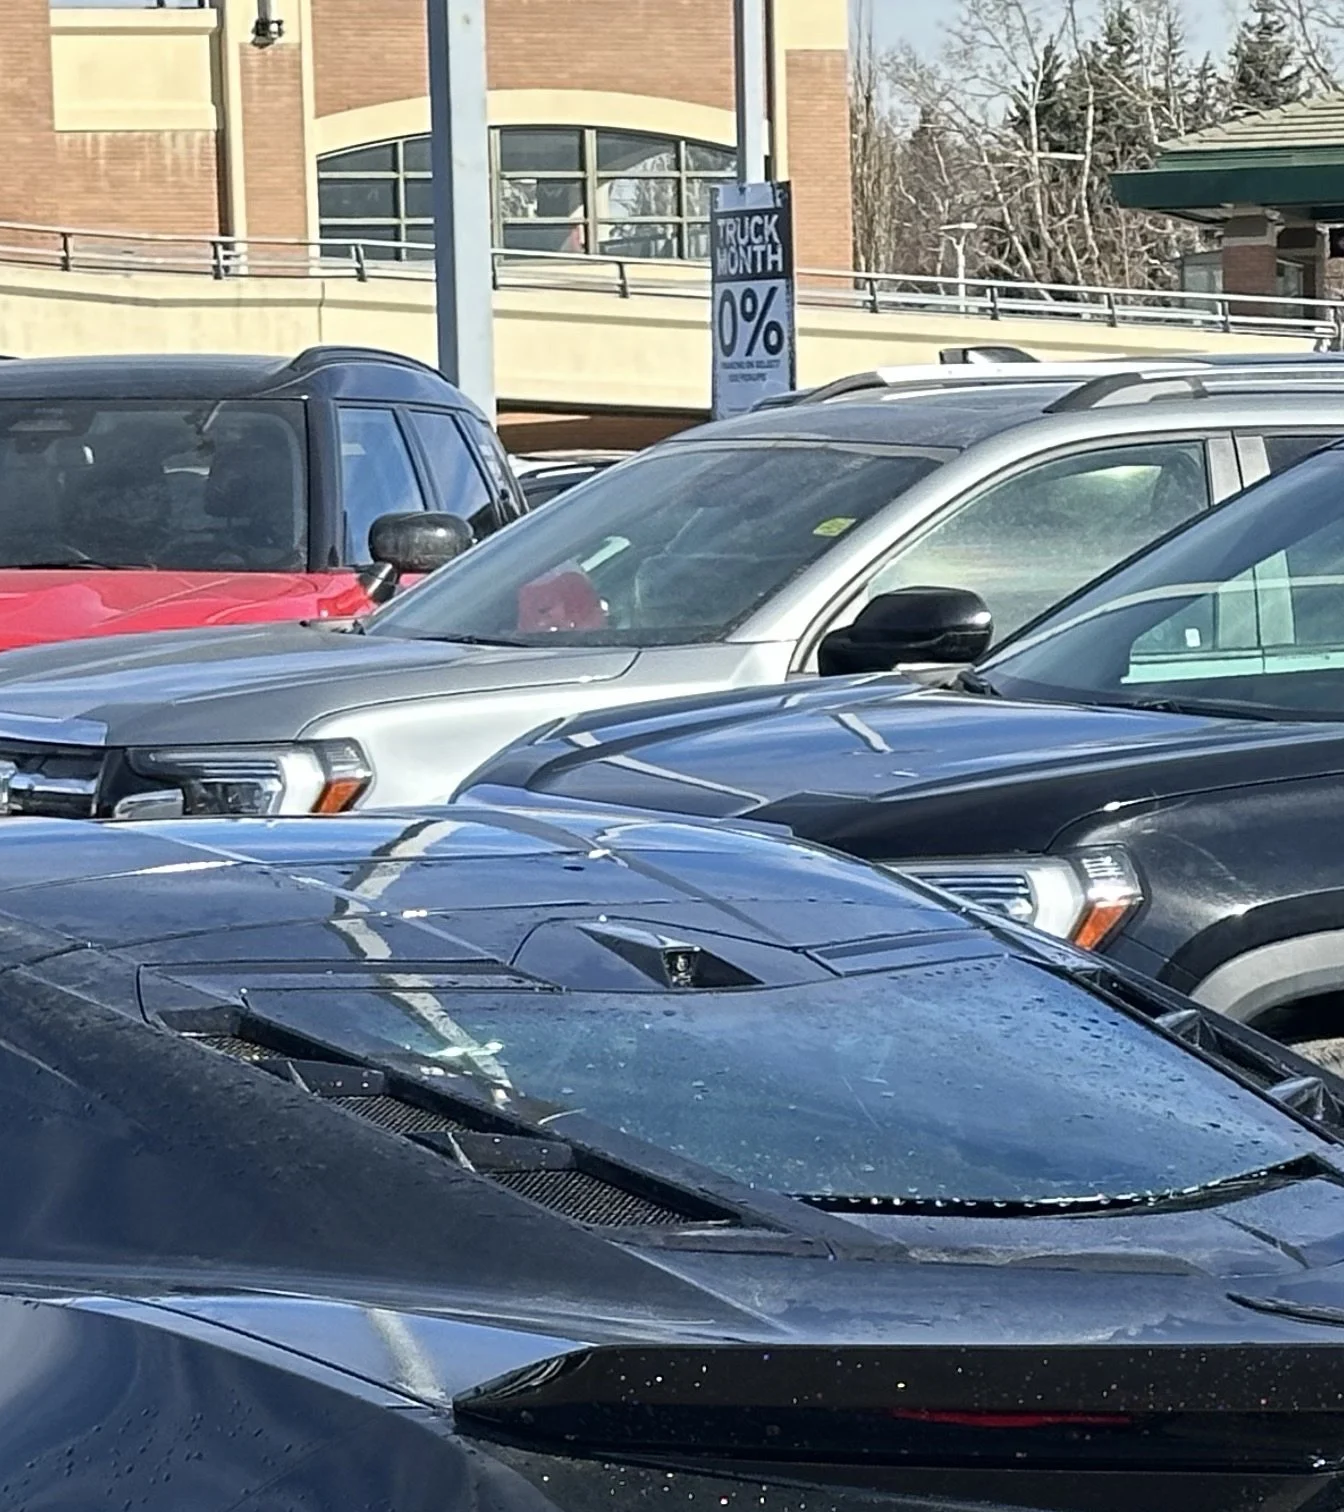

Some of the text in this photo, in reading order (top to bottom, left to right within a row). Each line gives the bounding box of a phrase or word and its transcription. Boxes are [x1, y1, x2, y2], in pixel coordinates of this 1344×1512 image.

[717, 214, 780, 247] TRUCK
[717, 243, 783, 276] MONTH
[718, 286, 784, 358] 0%
